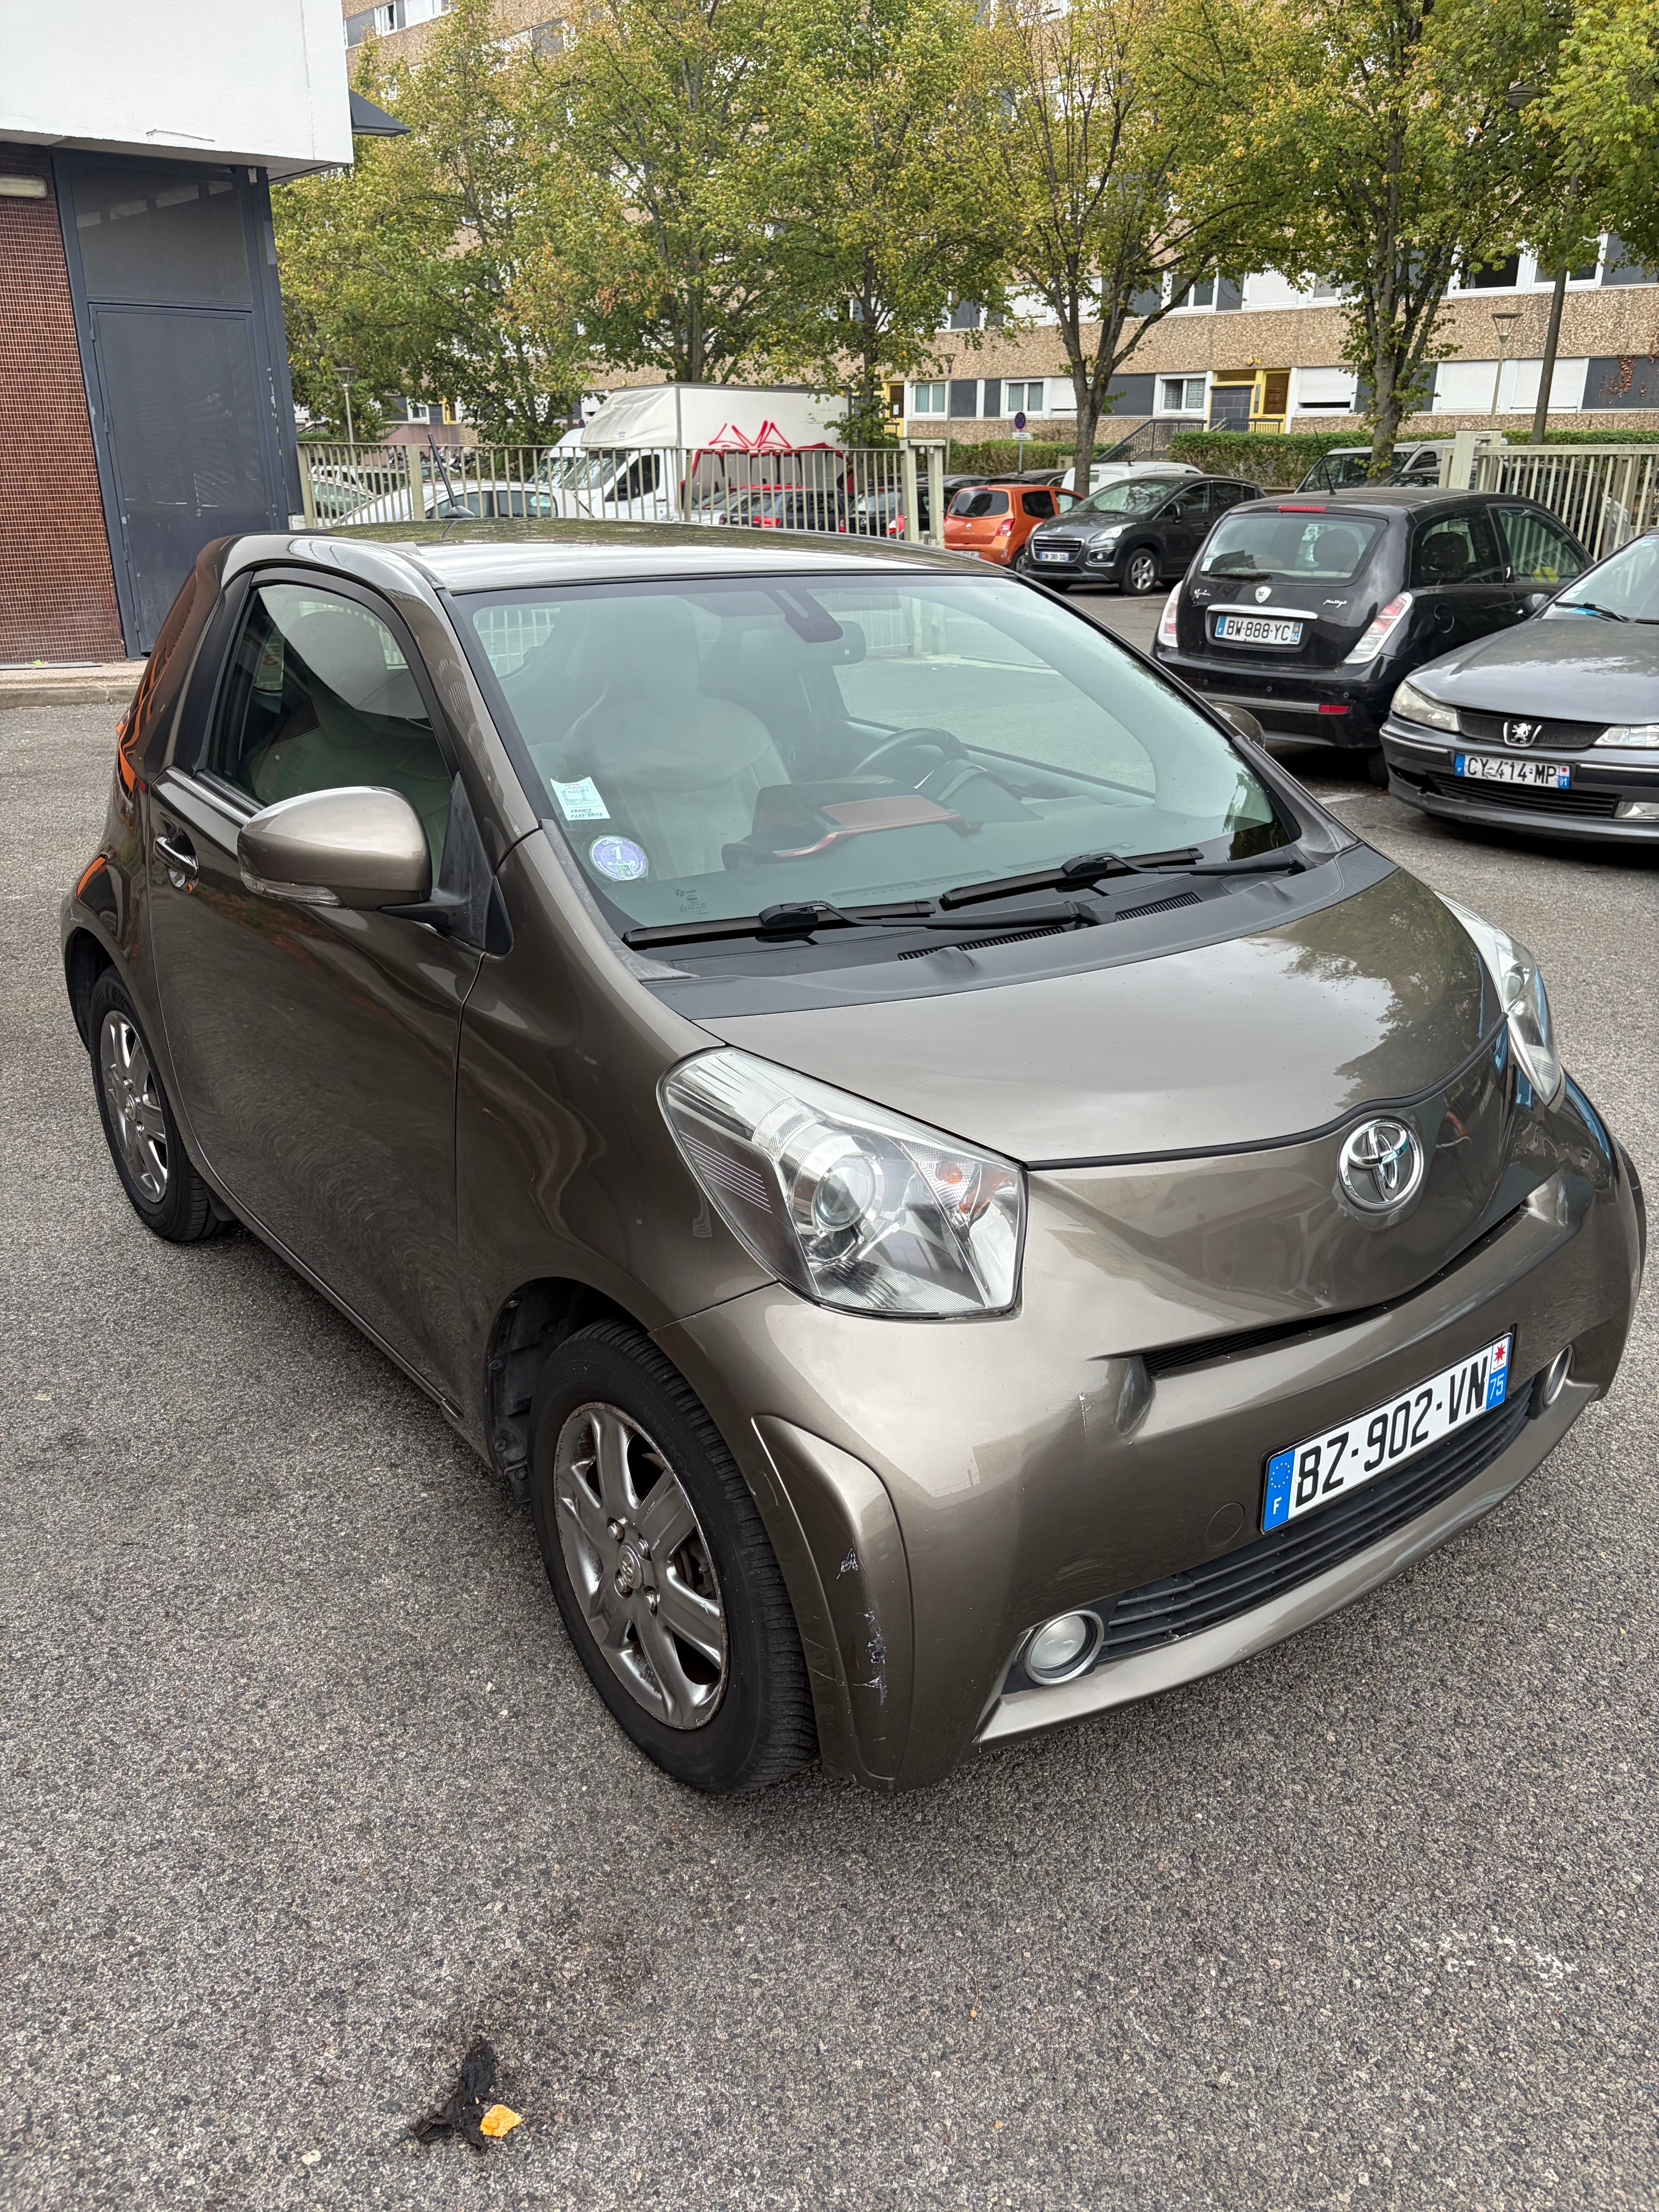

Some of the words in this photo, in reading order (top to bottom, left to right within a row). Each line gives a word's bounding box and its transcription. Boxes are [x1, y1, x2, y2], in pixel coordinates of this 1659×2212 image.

[1226, 620, 1290, 641] BW-888-YC
[1467, 757, 1557, 784] CY-414-MP
[1559, 777, 1567, 786] 91
[612, 846, 622, 860] 1
[1490, 1373, 1504, 1400] 75
[1295, 1355, 1488, 1508] BZ-902-VN
[1273, 1497, 1282, 1515] F
